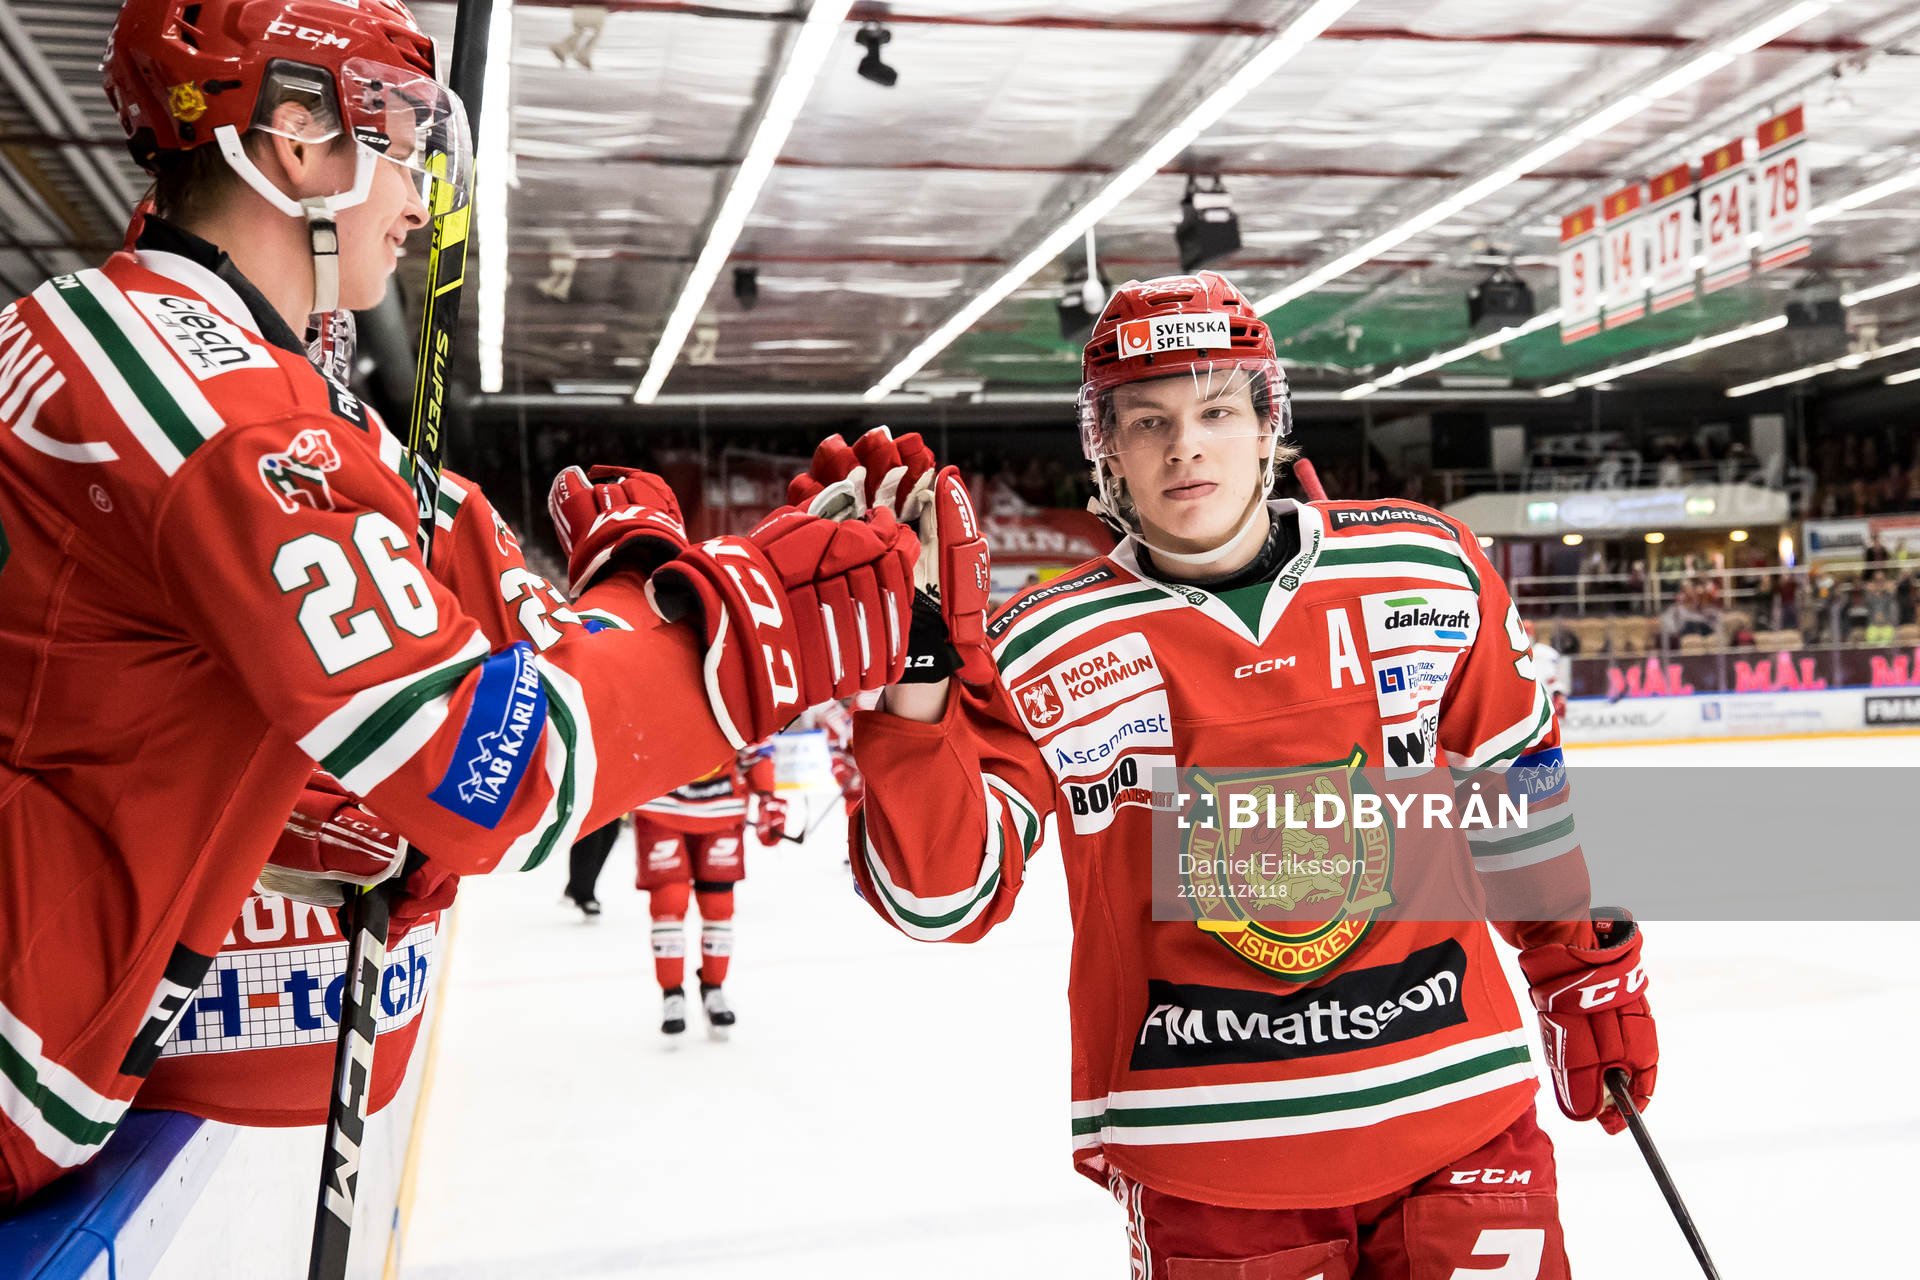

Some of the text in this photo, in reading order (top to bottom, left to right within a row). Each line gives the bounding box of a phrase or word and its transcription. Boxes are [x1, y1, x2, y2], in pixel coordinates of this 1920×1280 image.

[267, 20, 350, 50] CCM
[357, 133, 390, 145] CCM
[1765, 157, 1799, 218] 78
[1659, 211, 1681, 264] 17
[1710, 184, 1740, 244] 24
[1573, 252, 1585, 296] 9
[1613, 231, 1632, 283] 14
[156, 313, 217, 368] drink
[159, 297, 251, 366] clean
[1156, 320, 1227, 337] SVENSKA
[1157, 336, 1195, 350] SPEL
[426, 329, 448, 452] SUPER
[951, 488, 973, 538] CCM
[1337, 509, 1457, 539] FM Mattsson
[272, 512, 438, 677] 26
[992, 571, 1109, 634] FM Mattsson
[1384, 609, 1470, 630] dalakraft
[702, 539, 799, 709] CCM
[1326, 607, 1366, 689] A
[1060, 651, 1121, 686] MORA
[1067, 655, 1154, 701] KOMMUN
[1234, 655, 1296, 679] CCM
[1734, 651, 1828, 693] MÅL
[498, 702, 535, 757] KARL
[1073, 713, 1168, 764] scanmast
[485, 757, 512, 795] AB
[1070, 757, 1138, 816] BODO
[1140, 970, 1458, 1045] FM Mattsson
[1450, 1168, 1532, 1185] CCM
